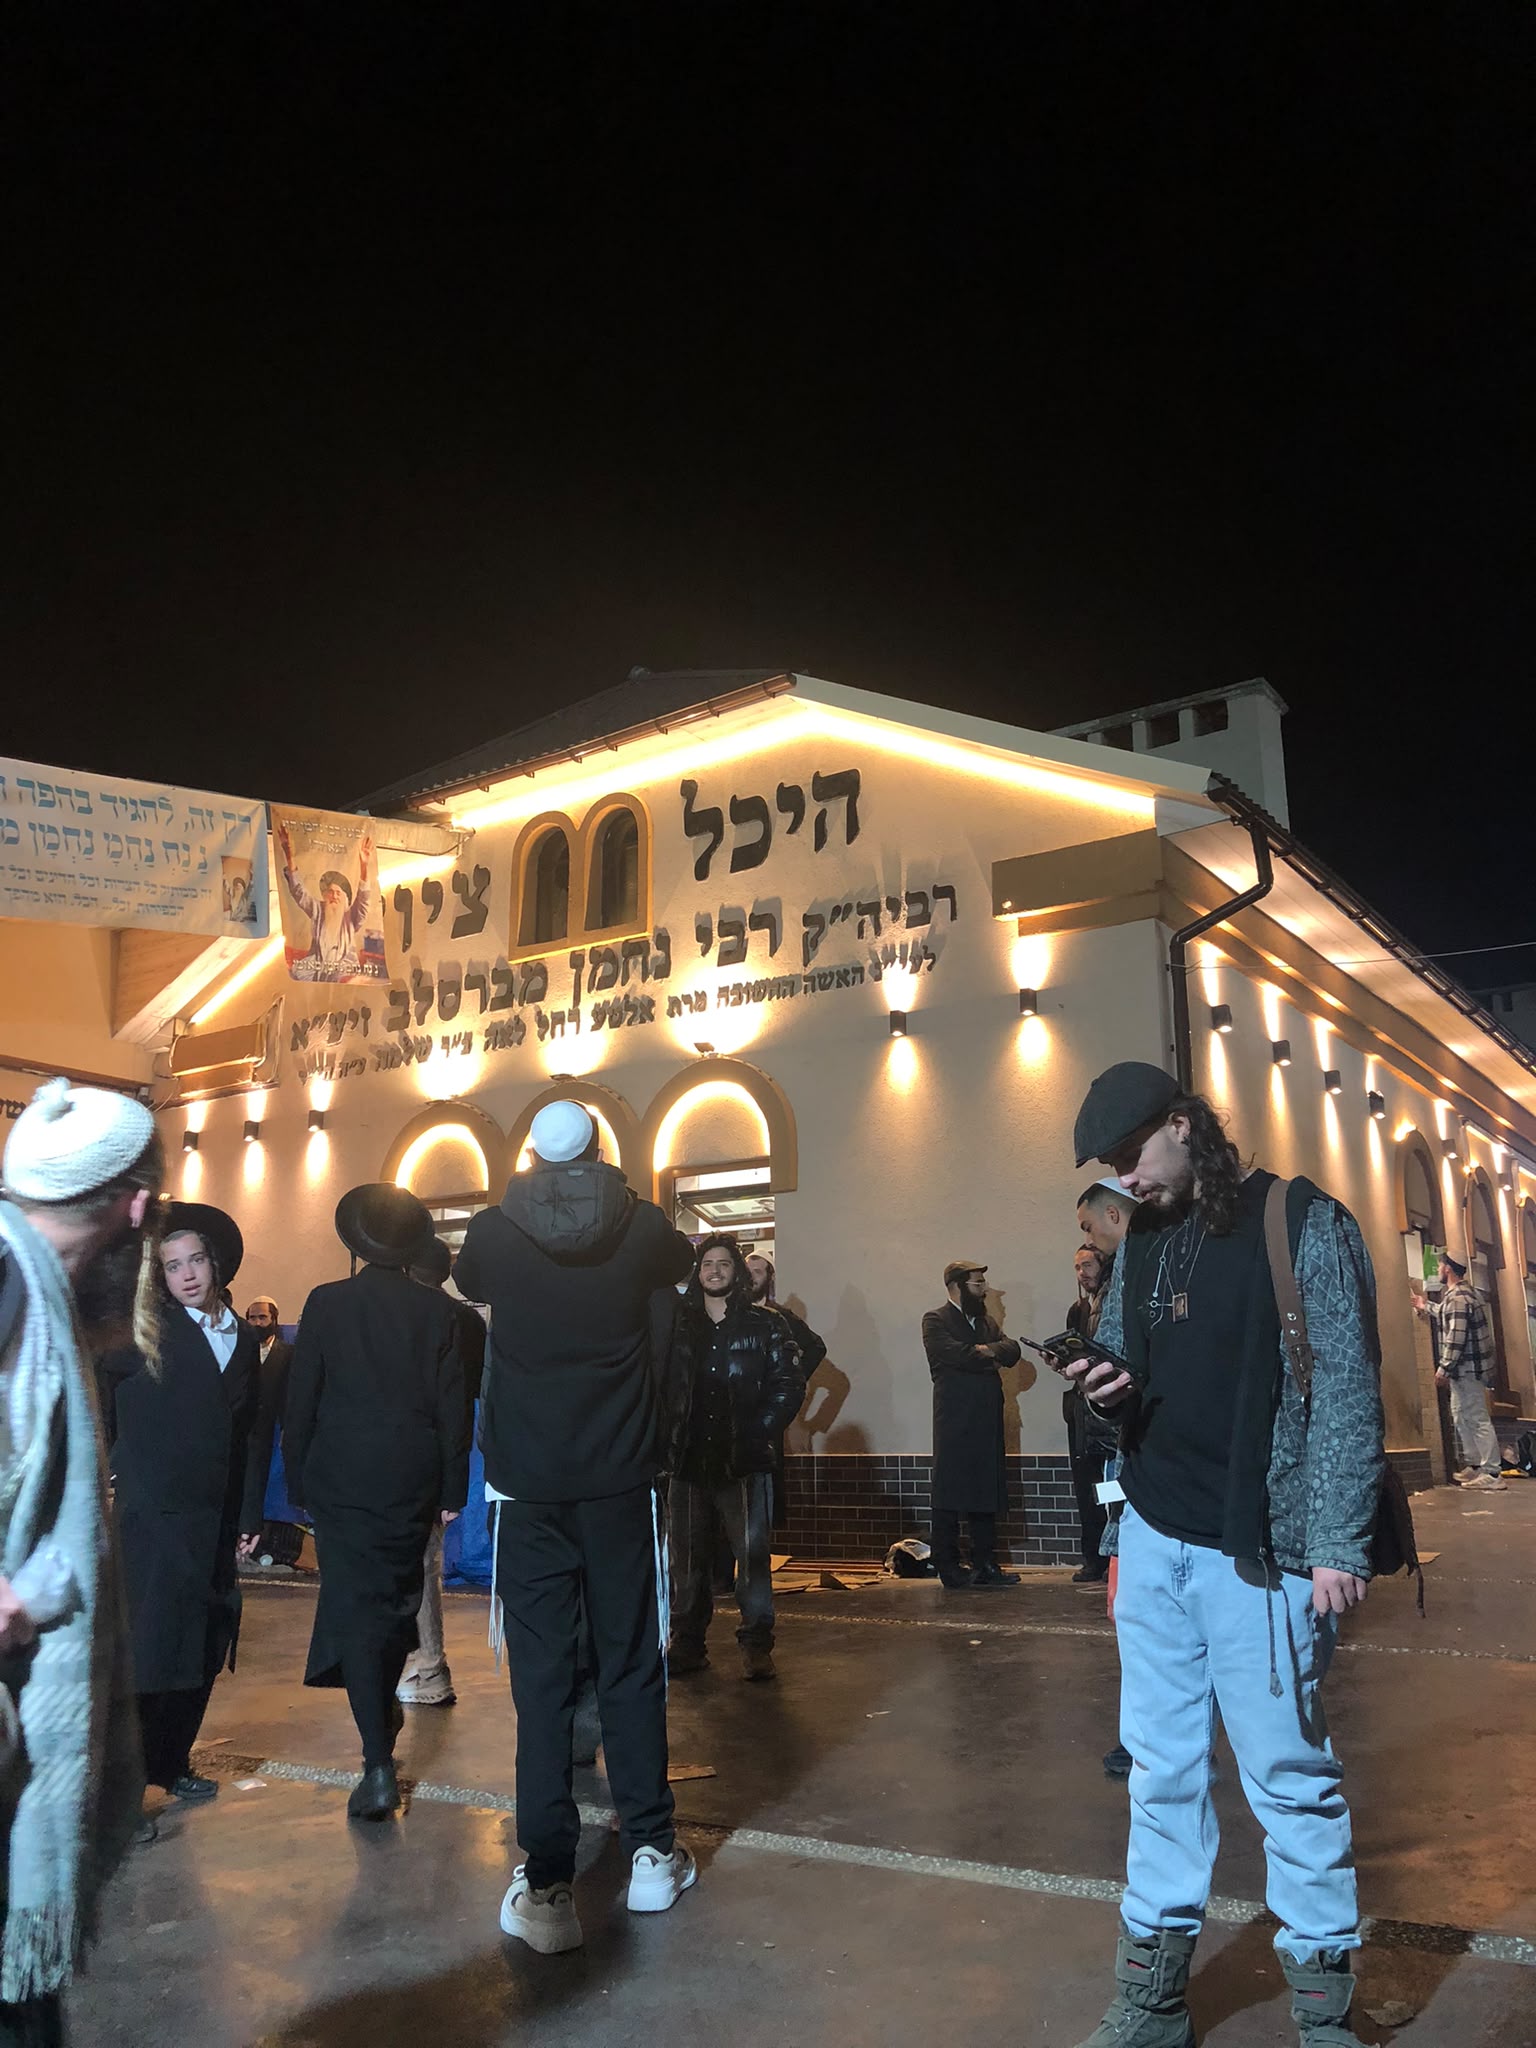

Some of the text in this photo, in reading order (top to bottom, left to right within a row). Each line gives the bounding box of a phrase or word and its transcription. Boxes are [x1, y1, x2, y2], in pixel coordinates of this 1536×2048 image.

[16, 777, 93, 815] בהפה
[99, 793, 174, 827] להגיד
[221, 811, 252, 845] רק
[680, 767, 861, 882] היכל
[380, 864, 491, 953] ציו
[696, 912, 779, 967] רבי
[569, 932, 672, 1009] נחמן
[803, 965, 865, 995] האשה
[385, 960, 549, 1033] מברסלב
[666, 988, 708, 1019] מרת
[716, 976, 796, 1009] החשובה
